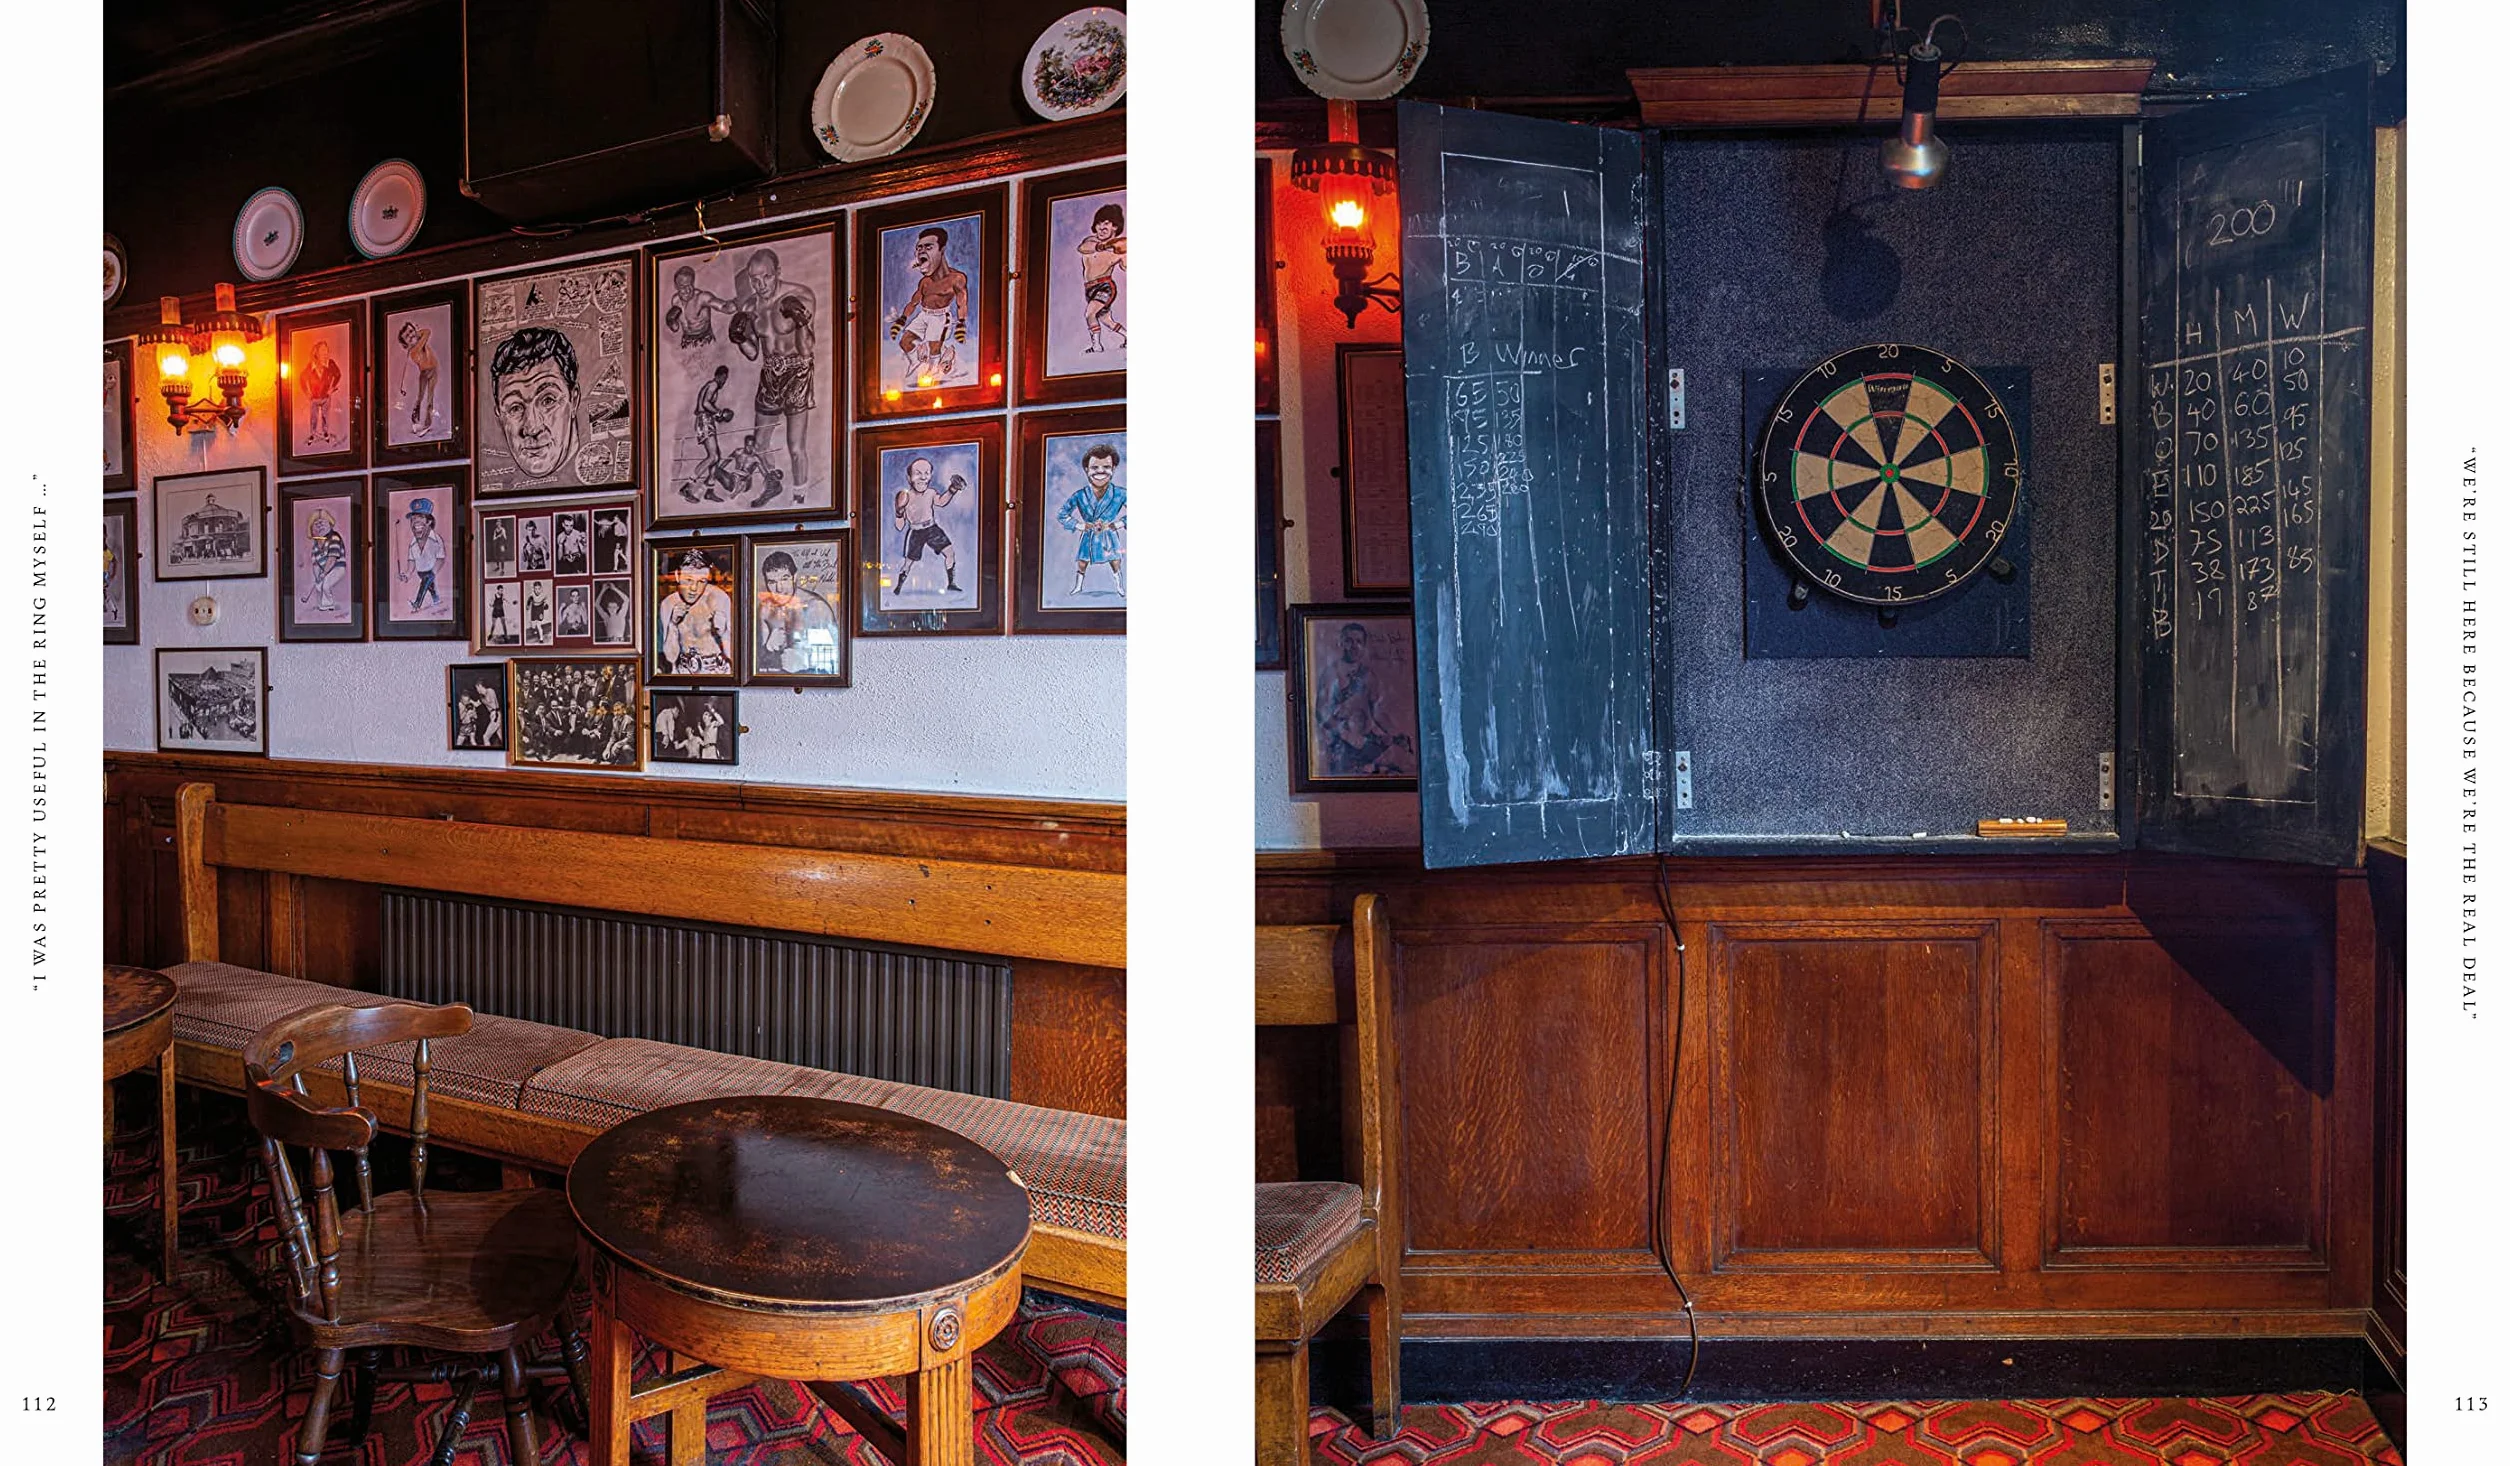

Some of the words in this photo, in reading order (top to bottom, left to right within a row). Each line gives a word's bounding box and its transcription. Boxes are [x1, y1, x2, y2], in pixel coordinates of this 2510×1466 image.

[2209, 200, 2276, 246] 200
[2185, 321, 2202, 345] H
[2234, 303, 2258, 337] M
[2279, 292, 2309, 330] W
[1460, 342, 1480, 367] B
[1496, 343, 1585, 370] Winner
[1878, 344, 1900, 359] 20
[1816, 360, 1837, 379] 10
[1941, 359, 1954, 373] 5
[2184, 369, 2211, 396] 20
[2232, 358, 2268, 384] 40
[2284, 347, 2305, 370] 10
[2283, 368, 2309, 391] 50
[1456, 381, 1487, 407] 65
[1496, 381, 1519, 406] 50
[1454, 407, 1487, 432] 95
[1496, 408, 1521, 429] 135
[1775, 407, 1793, 424] 15
[1984, 399, 2004, 419] 15
[2187, 397, 2216, 428] 40
[2234, 390, 2271, 416] 60
[2283, 402, 2309, 431] 95
[1458, 433, 1488, 457] 125
[2185, 431, 2219, 456] 70
[2234, 423, 2272, 450] 135
[1459, 457, 1489, 479] 150
[1764, 471, 1777, 484] 5
[2004, 458, 2018, 478] 10
[2186, 463, 2217, 488] 110
[2235, 458, 2271, 487] 185
[2282, 475, 2312, 500] 145
[2190, 498, 2225, 523] 150
[2232, 489, 2276, 515] 225
[2283, 500, 2314, 528] 165
[1779, 525, 1798, 549] 20
[1985, 520, 2005, 542] 20
[2189, 528, 2223, 556] 75
[2239, 525, 2275, 551] 113
[1823, 569, 1842, 587] 10
[1945, 568, 1958, 584] 5
[2191, 558, 2227, 584] 38
[2240, 557, 2275, 584] 173
[1884, 586, 1902, 601] 15
[2247, 585, 2276, 611] 87
